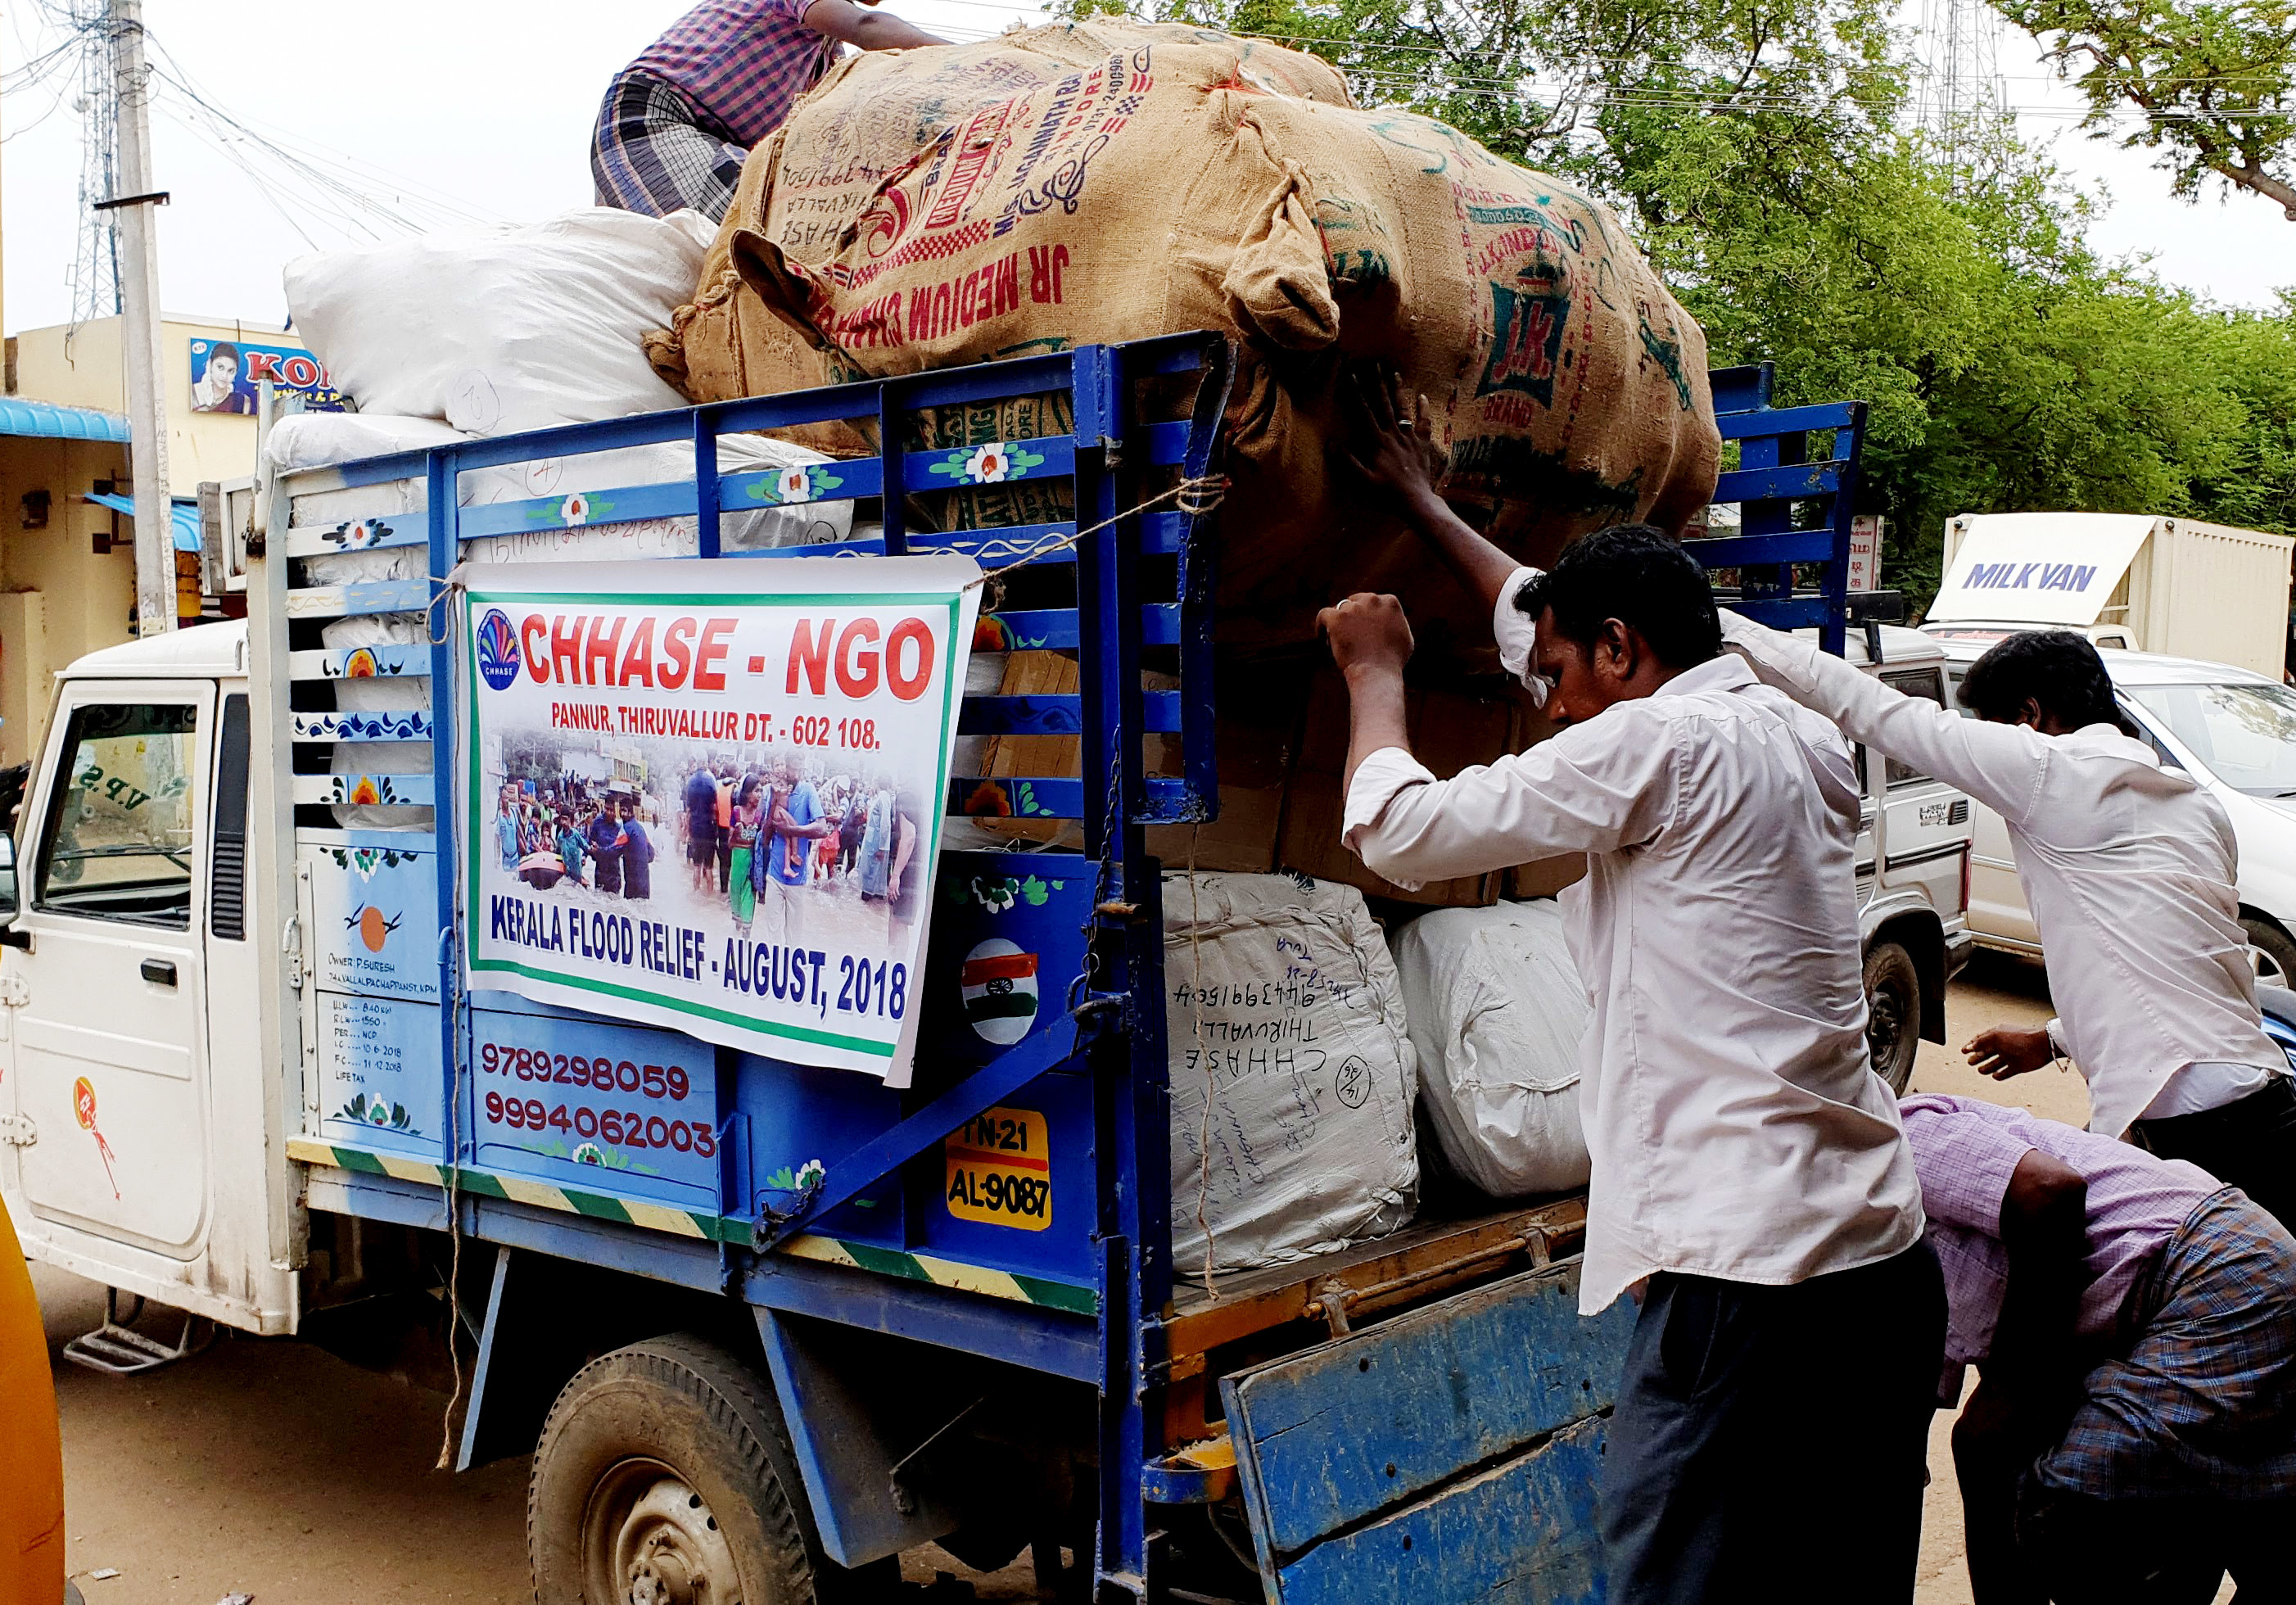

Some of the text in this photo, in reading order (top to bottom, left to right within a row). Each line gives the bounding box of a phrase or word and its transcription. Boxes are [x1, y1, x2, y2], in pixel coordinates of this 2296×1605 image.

[909, 251, 1021, 341] MEDIUM
[1028, 244, 1070, 305] JR
[1961, 563, 2098, 593] MILK VAN
[521, 613, 739, 691] CHHASE
[784, 617, 936, 702] NGO
[551, 702, 616, 739] PANNUR,
[617, 705, 739, 742] THIRUVALLUR
[743, 712, 774, 744] DT.
[792, 714, 829, 748] 602
[836, 717, 881, 751] 108.
[490, 893, 565, 955] KERALA
[569, 907, 635, 968] FLOOD
[640, 919, 707, 983] RELIEF
[722, 937, 827, 1020] AUGUST,
[836, 954, 907, 1021] 2018
[481, 1042, 689, 1102] 9789298059
[1186, 1048, 1327, 1078] CHHASE
[486, 1092, 716, 1160] 9994062003
